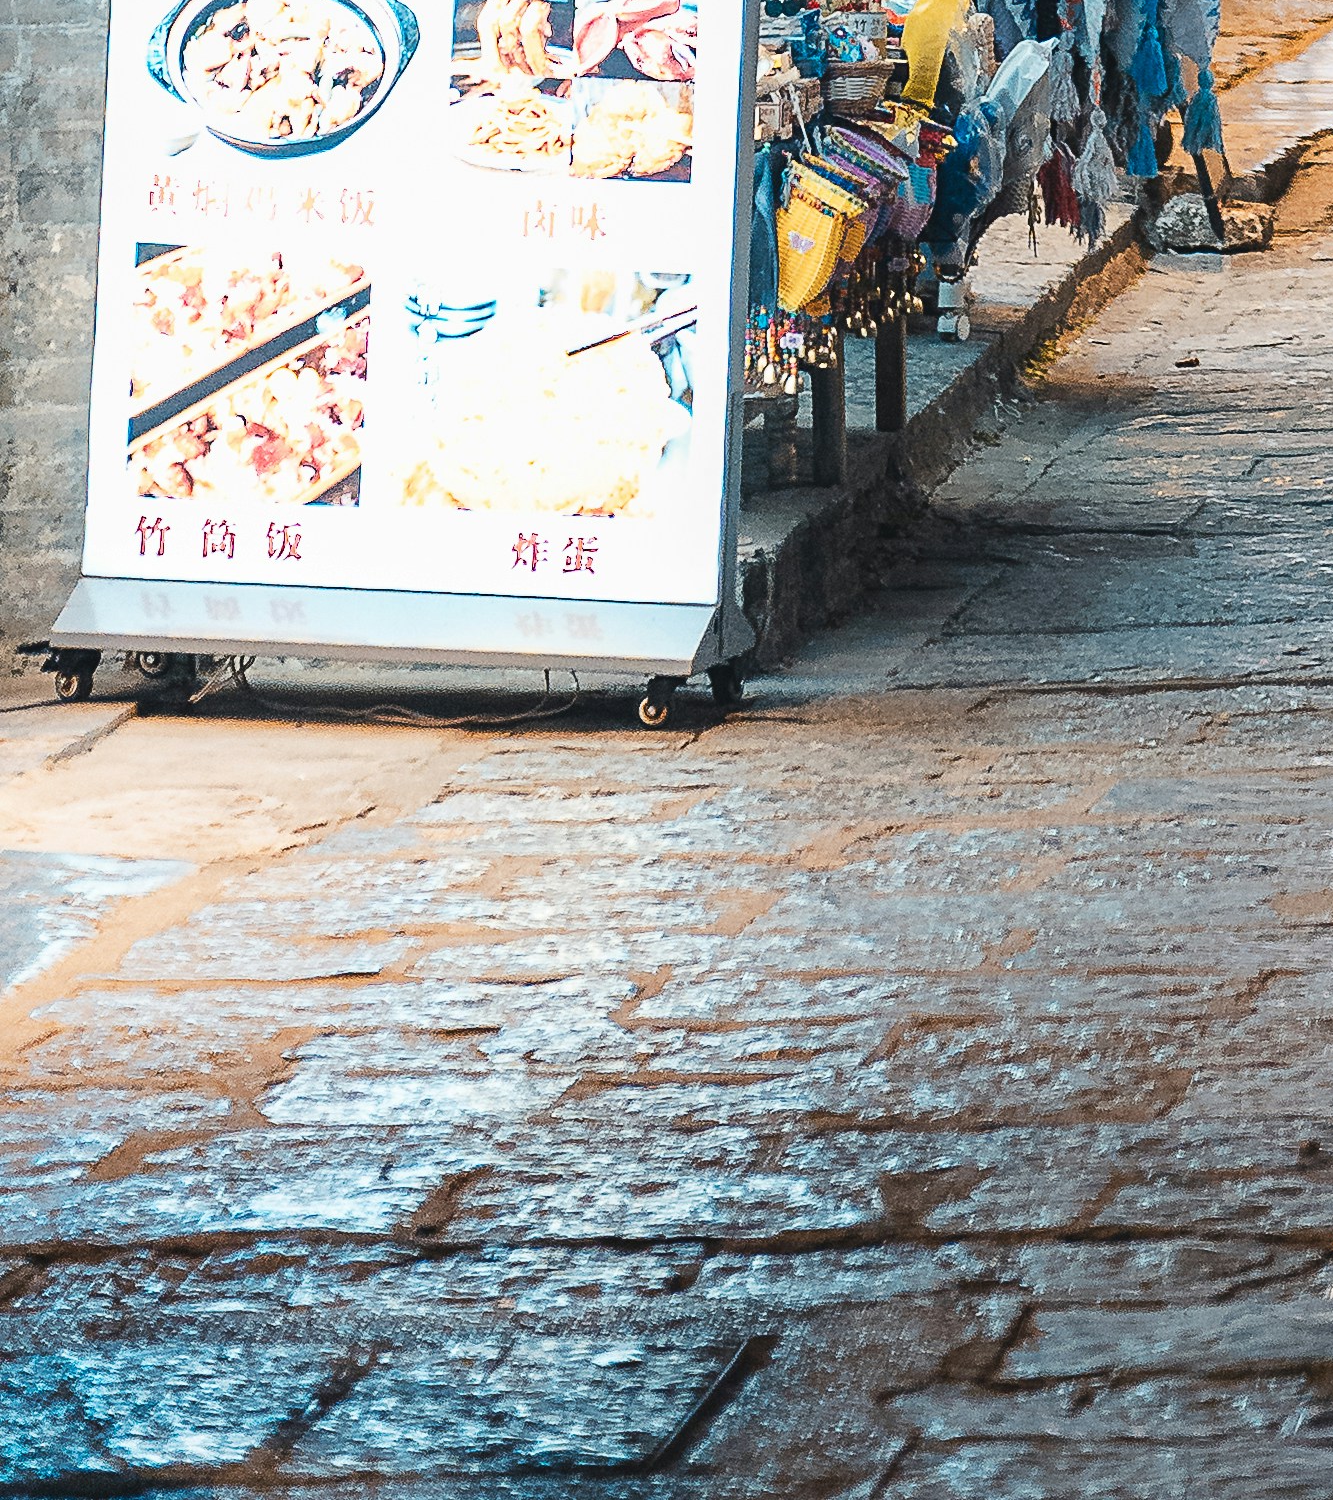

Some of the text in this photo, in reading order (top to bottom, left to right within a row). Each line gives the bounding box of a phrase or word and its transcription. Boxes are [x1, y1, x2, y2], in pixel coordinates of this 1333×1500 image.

[134, 515, 303, 561] 竹筒饭
[511, 531, 600, 575] 炸蛋
